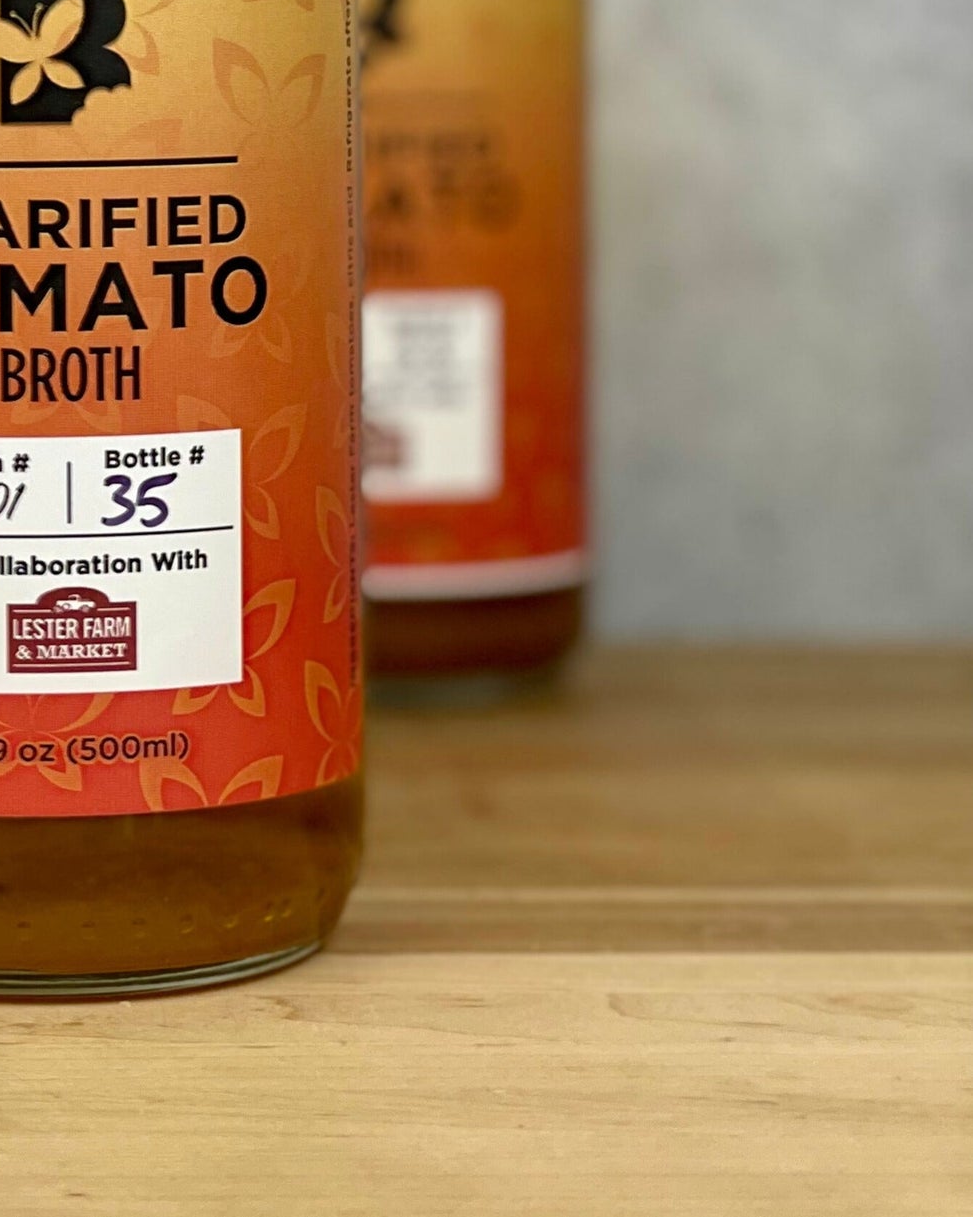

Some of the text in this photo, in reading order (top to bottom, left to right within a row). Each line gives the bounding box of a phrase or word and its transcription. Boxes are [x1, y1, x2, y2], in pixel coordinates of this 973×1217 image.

[0, 346, 142, 402] BROTH
[13, 453, 30, 473] #
[104, 445, 205, 469] Bottle #
[101, 472, 178, 528] 35
[151, 549, 208, 572] With
[12, 616, 131, 640] LESTER FARM
[15, 643, 127, 660] & MARKET
[18, 743, 55, 762] oz
[65, 733, 189, 765] (500ml)
